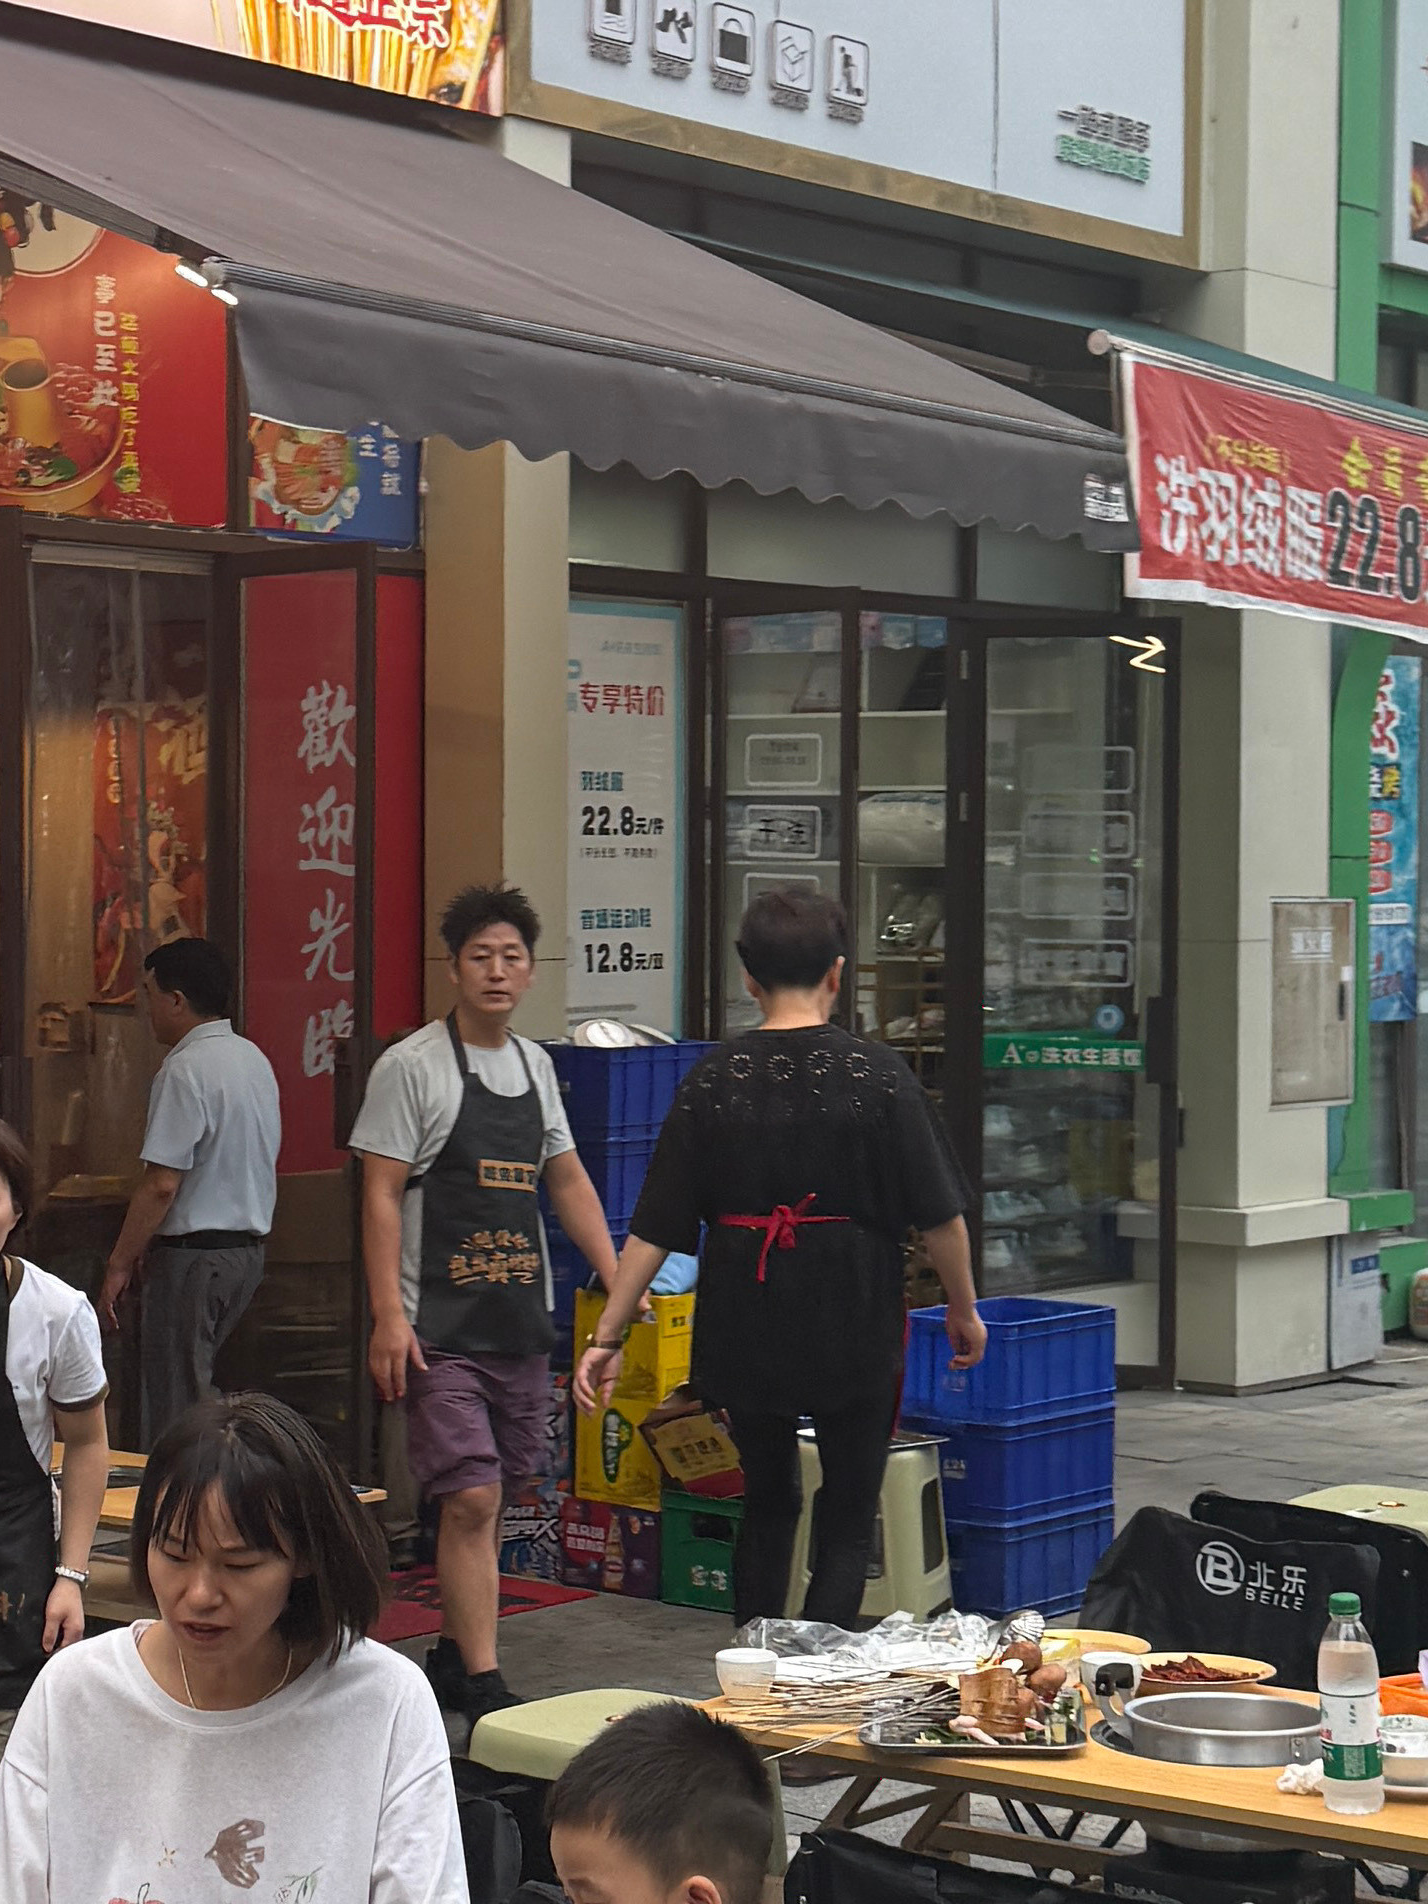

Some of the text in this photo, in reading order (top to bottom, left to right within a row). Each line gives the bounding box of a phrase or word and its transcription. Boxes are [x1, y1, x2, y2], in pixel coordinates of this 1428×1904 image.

[579, 681, 665, 716] 专享特价
[1247, 1560, 1308, 1596] 北乐
[1245, 1586, 1305, 1612] BEILE
